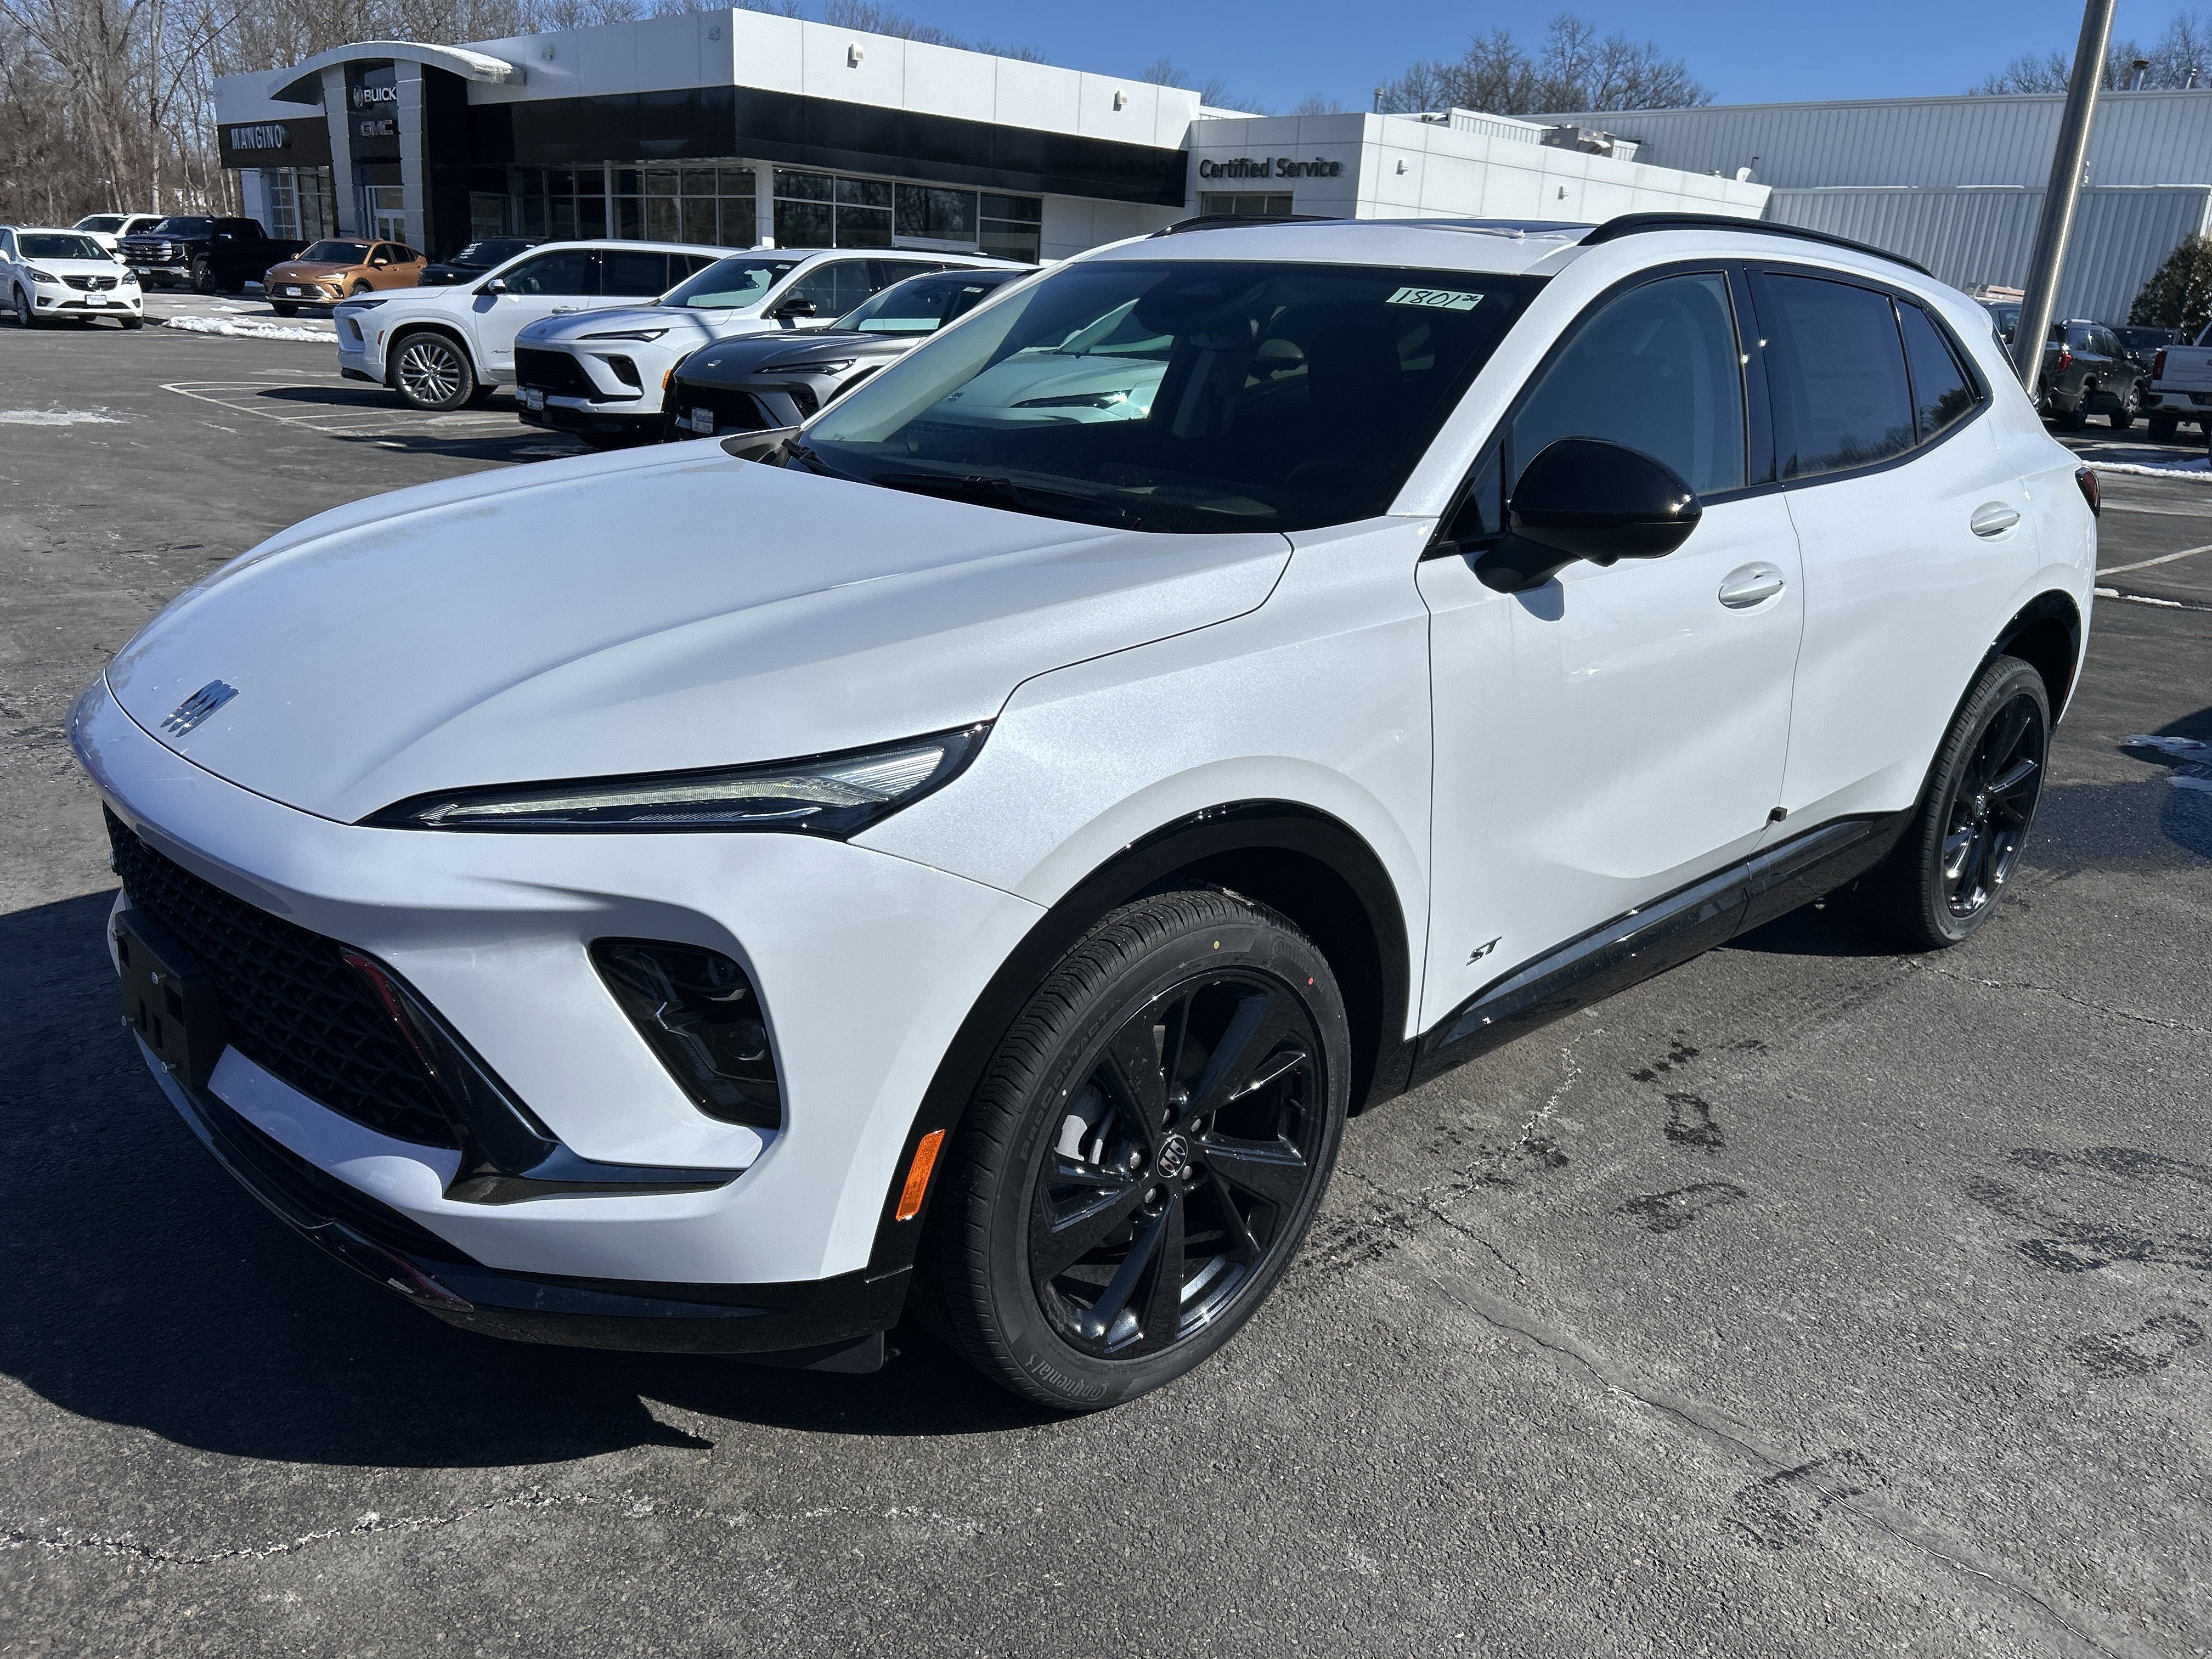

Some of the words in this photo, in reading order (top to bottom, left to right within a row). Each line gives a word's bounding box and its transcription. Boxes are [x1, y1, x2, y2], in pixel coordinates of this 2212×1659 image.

[364, 87, 397, 102] BUICK
[231, 125, 283, 150] MANGINO
[360, 120, 394, 137] GMC
[1200, 157, 1270, 178] Certified
[1276, 156, 1340, 178] Service
[1396, 290, 1462, 307] 1801
[1465, 935, 1503, 966] ST
[1030, 1358, 1109, 1401] Continental
